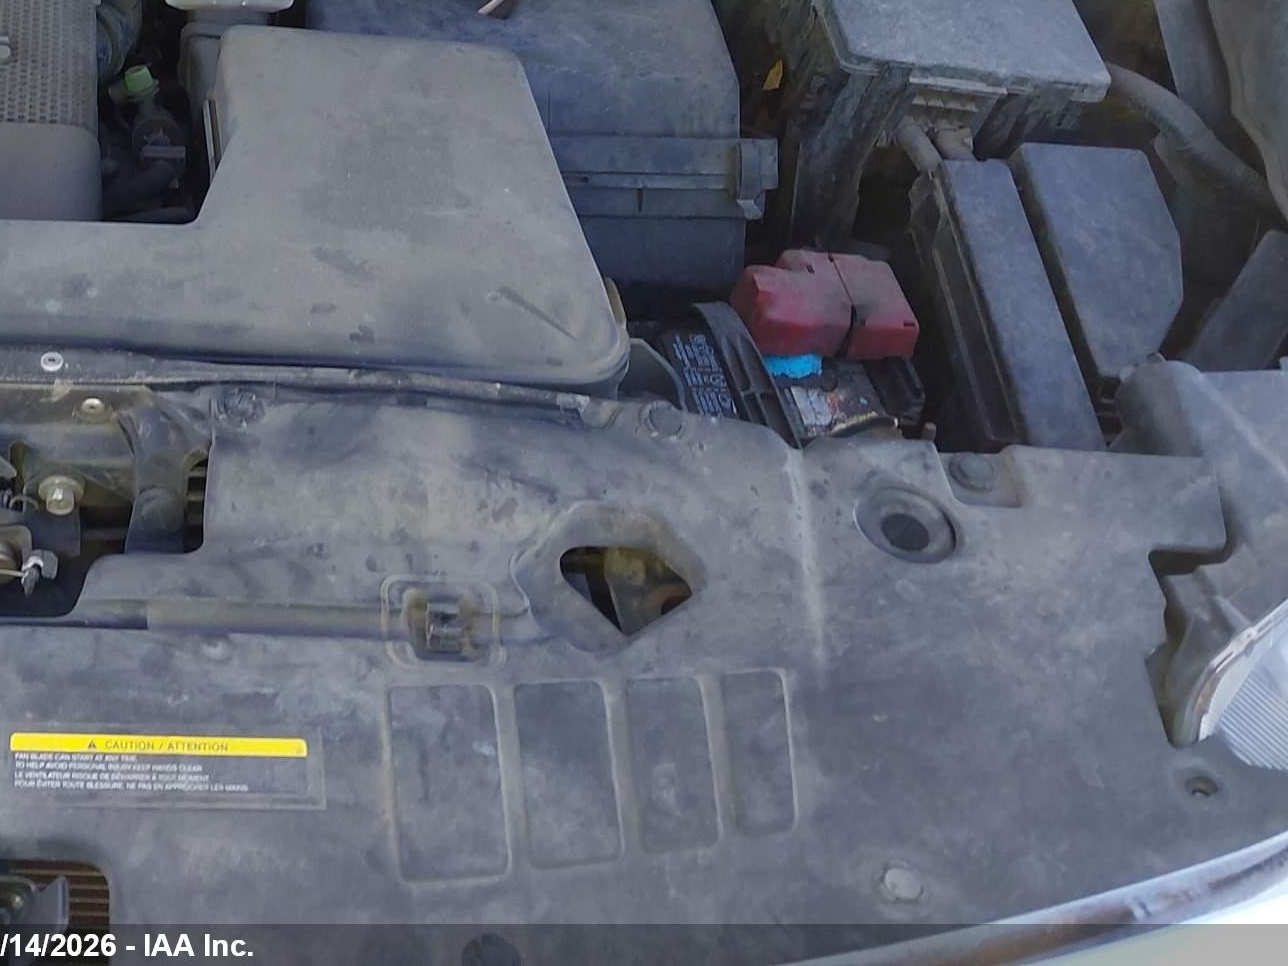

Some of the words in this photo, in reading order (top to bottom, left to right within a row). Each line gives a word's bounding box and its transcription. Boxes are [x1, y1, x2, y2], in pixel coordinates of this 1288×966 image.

[104, 740, 154, 751] CAUTION
[167, 741, 228, 752] ATTENTION
[26, 762, 45, 771] HELP
